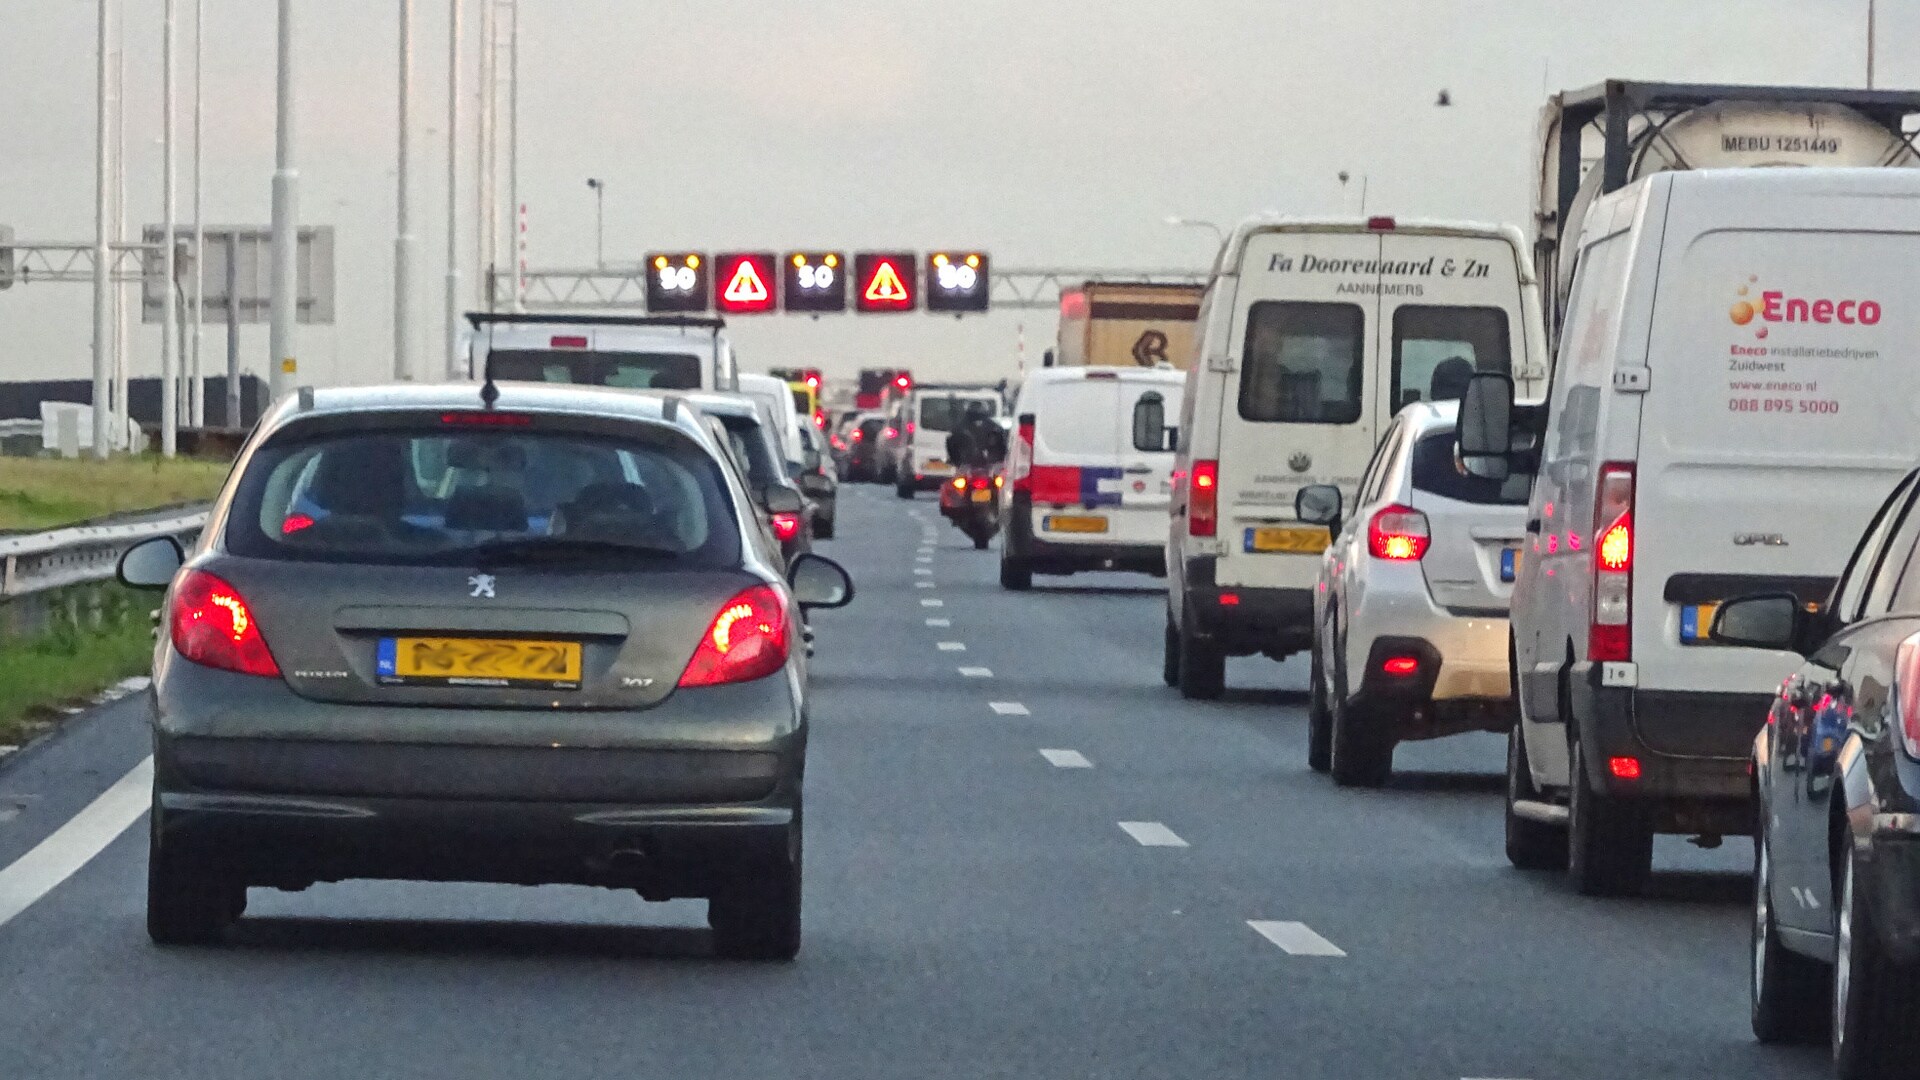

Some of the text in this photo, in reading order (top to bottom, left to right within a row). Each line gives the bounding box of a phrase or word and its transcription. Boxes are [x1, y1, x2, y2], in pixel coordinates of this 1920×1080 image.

[1725, 136, 1838, 153] MEBU 1251449
[1268, 253, 1293, 273] Fa
[1440, 258, 1456, 277] &
[1462, 258, 1490, 278] Zn
[798, 264, 834, 288] 50
[1336, 283, 1424, 297] AANNEMERS
[1762, 290, 1881, 326] Eneco
[1730, 344, 1768, 356] Eneco
[1729, 359, 1786, 372] Zuidwest
[1729, 399, 1839, 414] 088 895 5000
